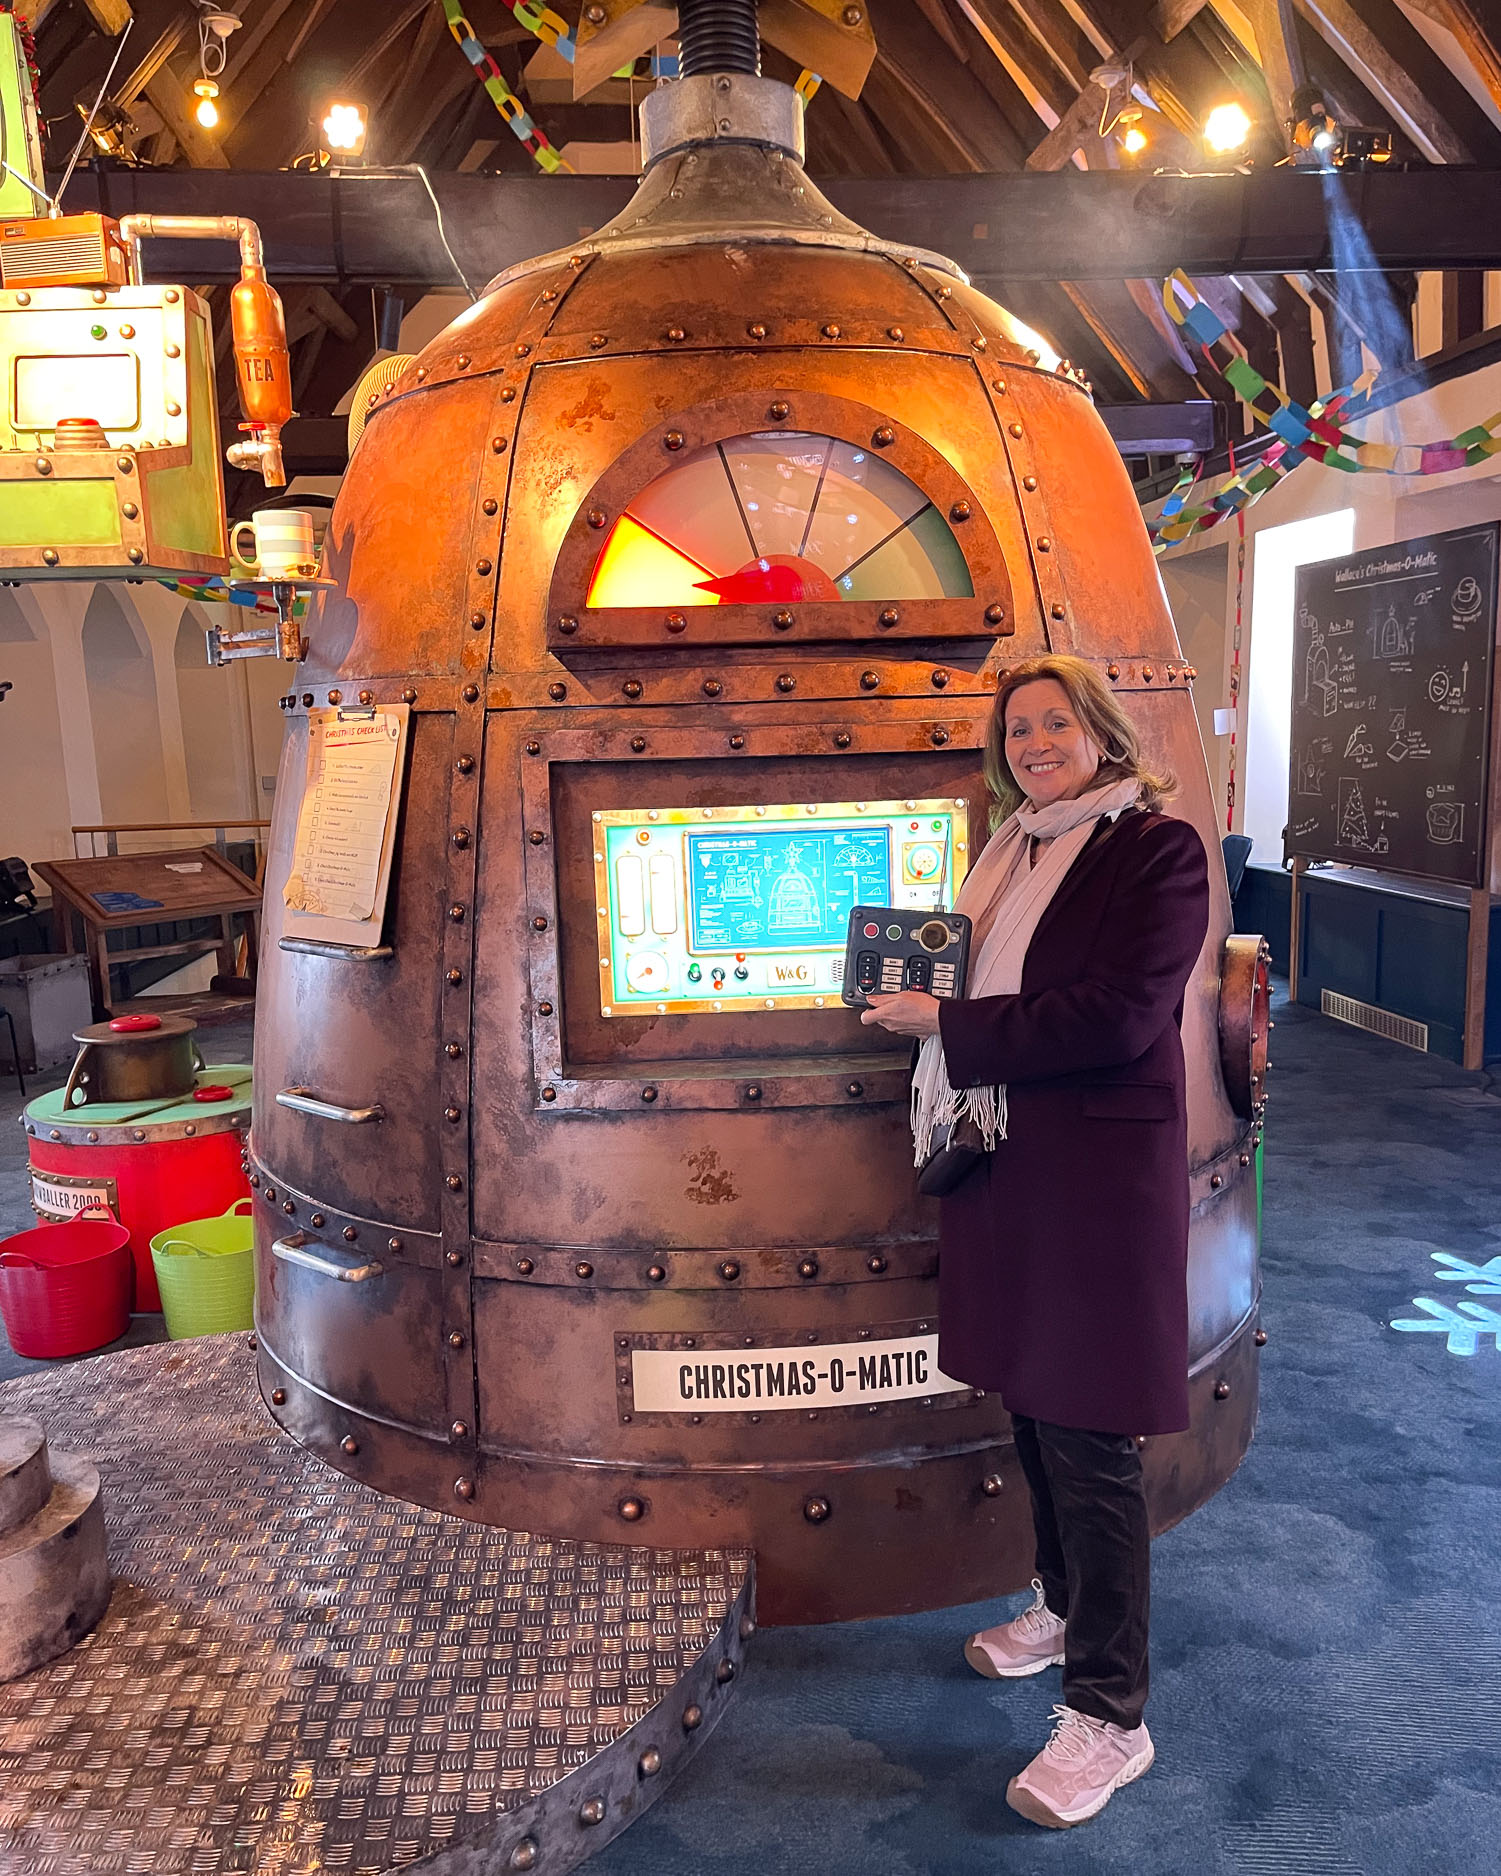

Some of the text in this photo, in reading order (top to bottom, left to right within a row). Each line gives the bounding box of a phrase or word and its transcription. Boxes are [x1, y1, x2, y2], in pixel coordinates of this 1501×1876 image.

[244, 359, 275, 381] TEA
[1335, 551, 1437, 583] Wallace's Christmas-O-Matic
[325, 727, 355, 739] CHRISTMS
[356, 726, 375, 736] CHECK
[775, 965, 808, 981] W&G
[679, 1349, 928, 1400] CHRISTMAS-O-MATIC
